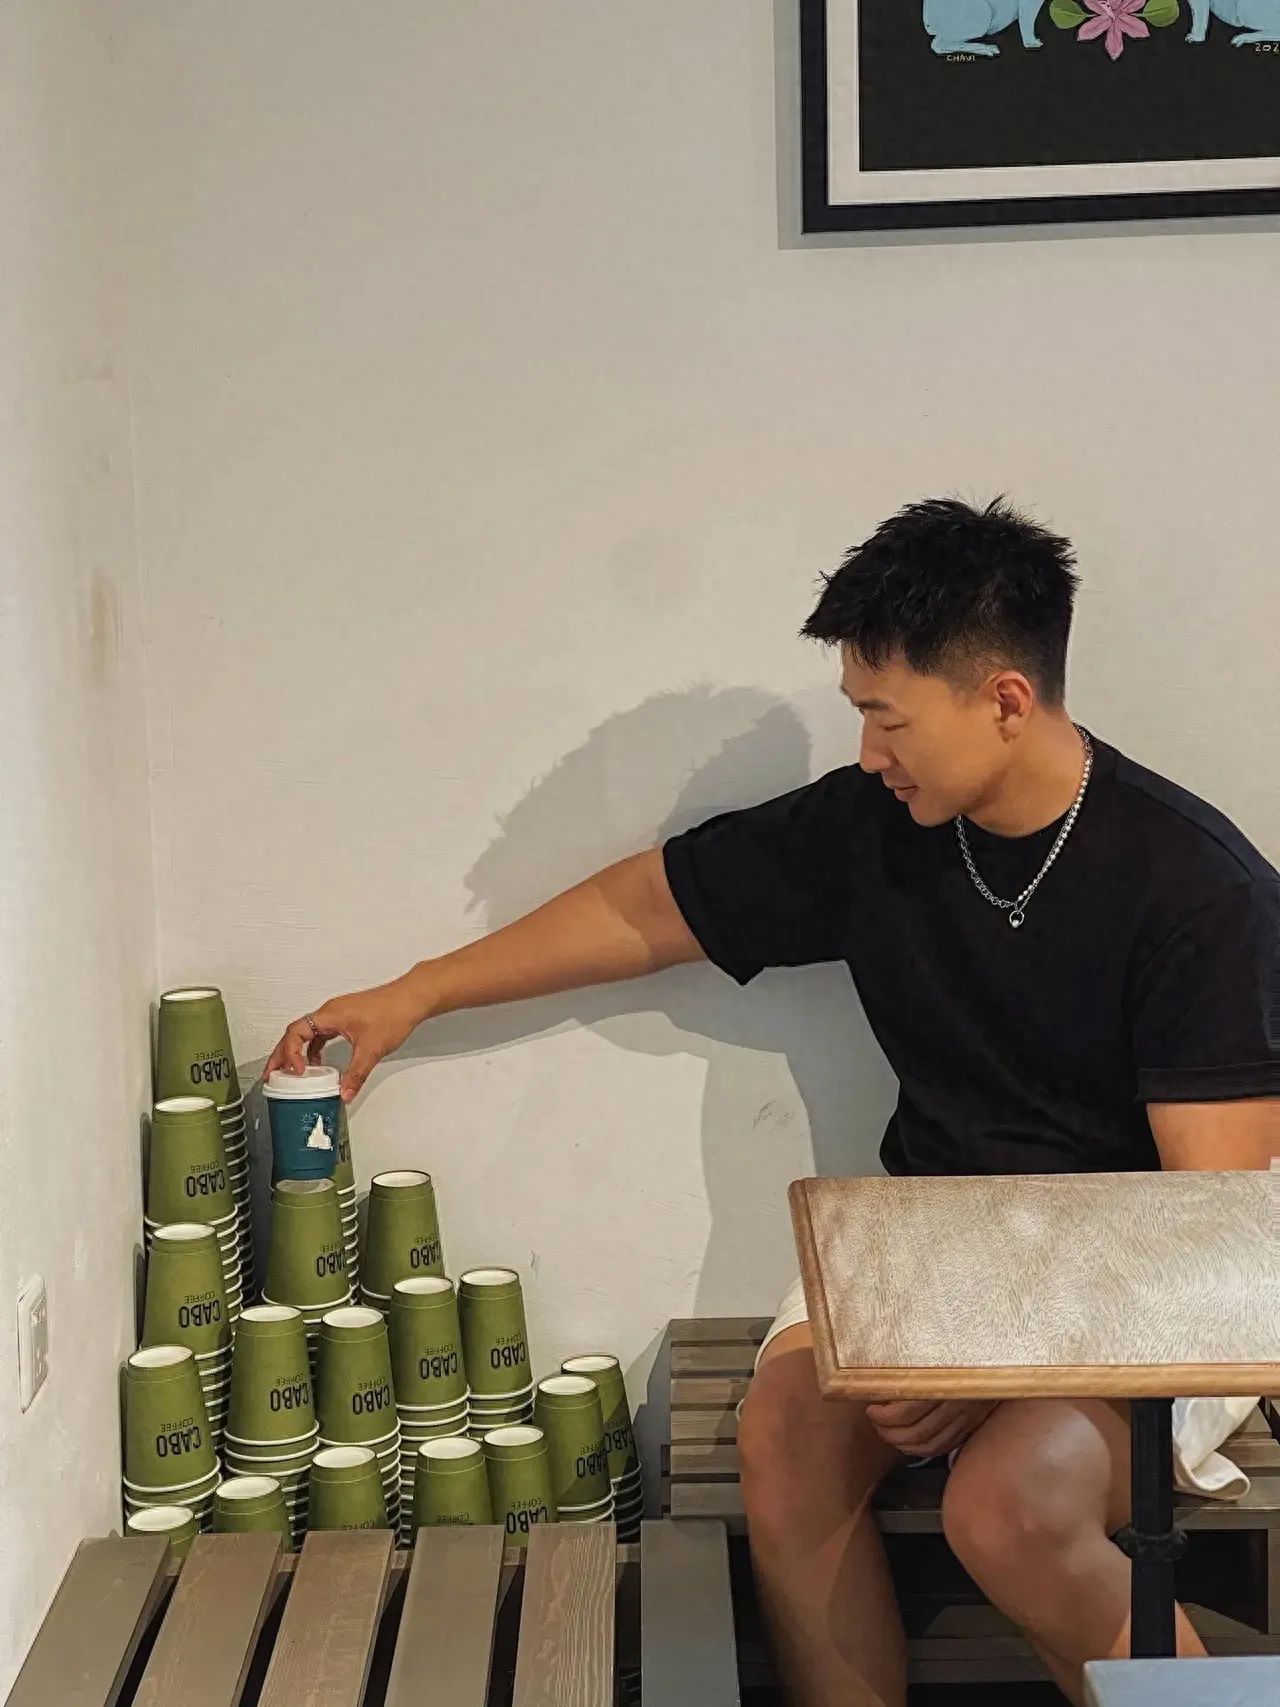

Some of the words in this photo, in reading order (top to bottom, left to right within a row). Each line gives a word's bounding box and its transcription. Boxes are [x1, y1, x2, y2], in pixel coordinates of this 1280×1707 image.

[194, 1049, 224, 1060] COFFEE
[190, 1057, 230, 1084] CABO
[190, 1161, 220, 1173] COFFEE
[186, 1169, 226, 1197] CABO
[410, 1240, 442, 1268] CABO
[184, 1291, 215, 1304] COFFEE
[179, 1300, 221, 1328] CABO
[420, 1352, 458, 1379] CABO
[491, 1342, 526, 1369] CABO
[357, 1376, 386, 1390] COFFEE
[270, 1383, 309, 1411] CABO
[352, 1385, 390, 1415] CABO
[160, 1417, 194, 1432] COFFEE
[156, 1426, 201, 1457] CABO
